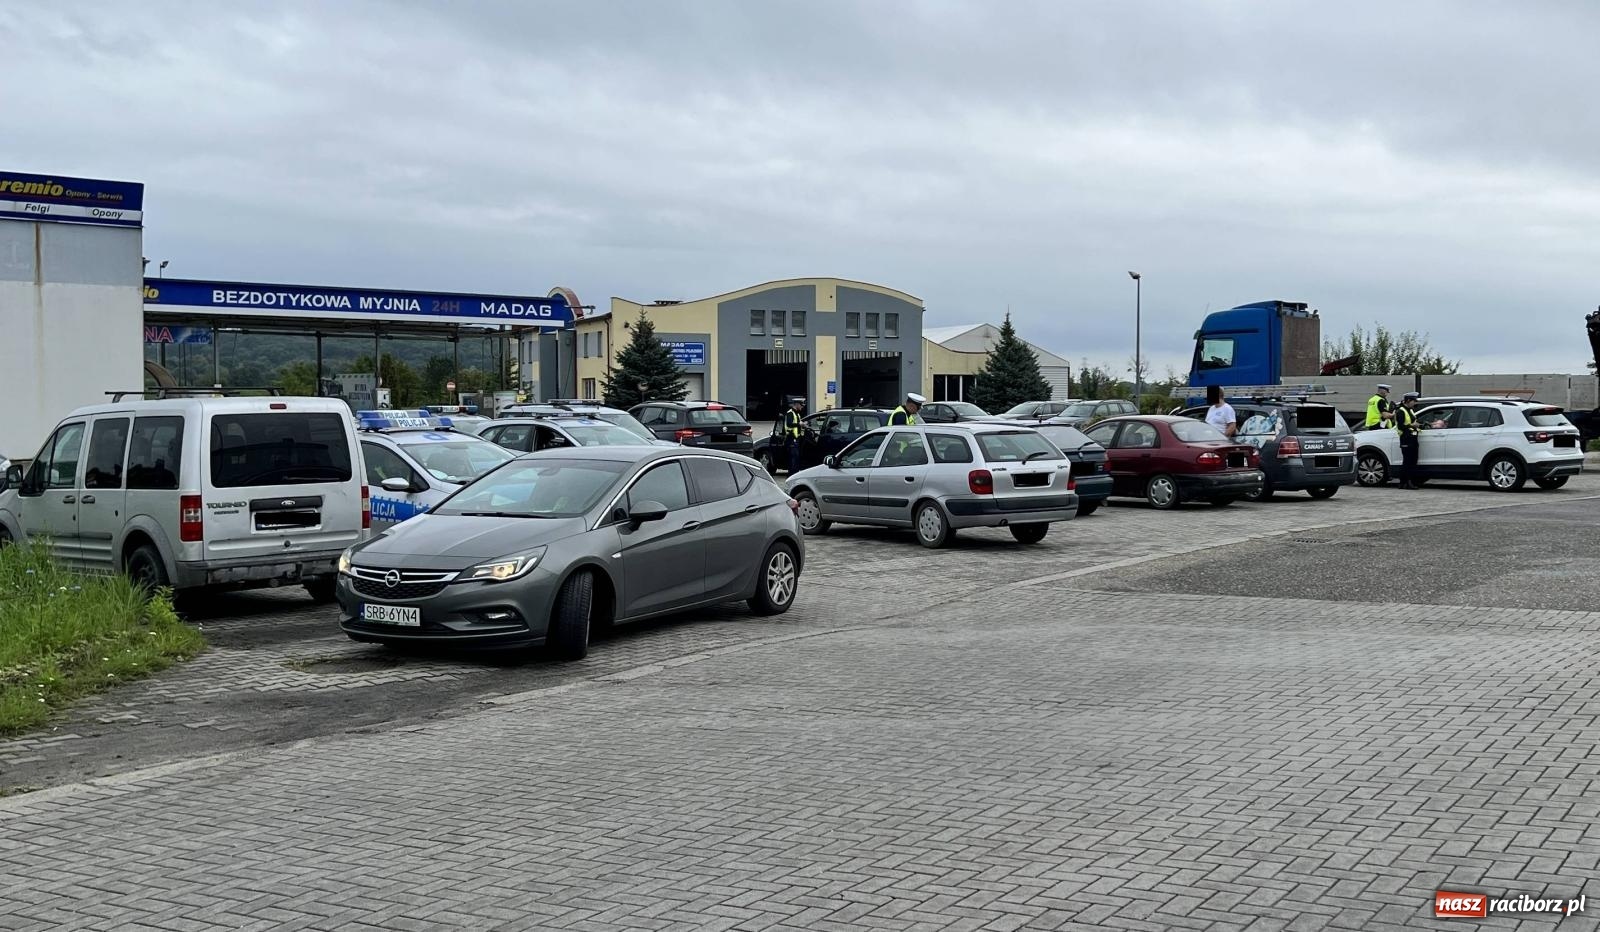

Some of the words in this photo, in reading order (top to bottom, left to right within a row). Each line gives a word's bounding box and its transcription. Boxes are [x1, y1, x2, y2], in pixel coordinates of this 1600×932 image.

[0, 180, 64, 196] remio
[65, 189, 92, 199] Opony
[97, 192, 123, 200] Serwis
[24, 203, 51, 213] Felgi
[92, 208, 123, 219] Opony
[212, 290, 352, 309] BEZDOTYKOWA
[359, 296, 421, 312] MYJNIA
[431, 300, 461, 313] 24H
[480, 302, 552, 317] MADAG
[144, 326, 174, 343] NA
[398, 419, 427, 427] POLICJA
[206, 501, 247, 509] TOURNEO
[371, 502, 396, 517] LICJA
[366, 605, 386, 620] SRB
[389, 607, 417, 623] 6YN4
